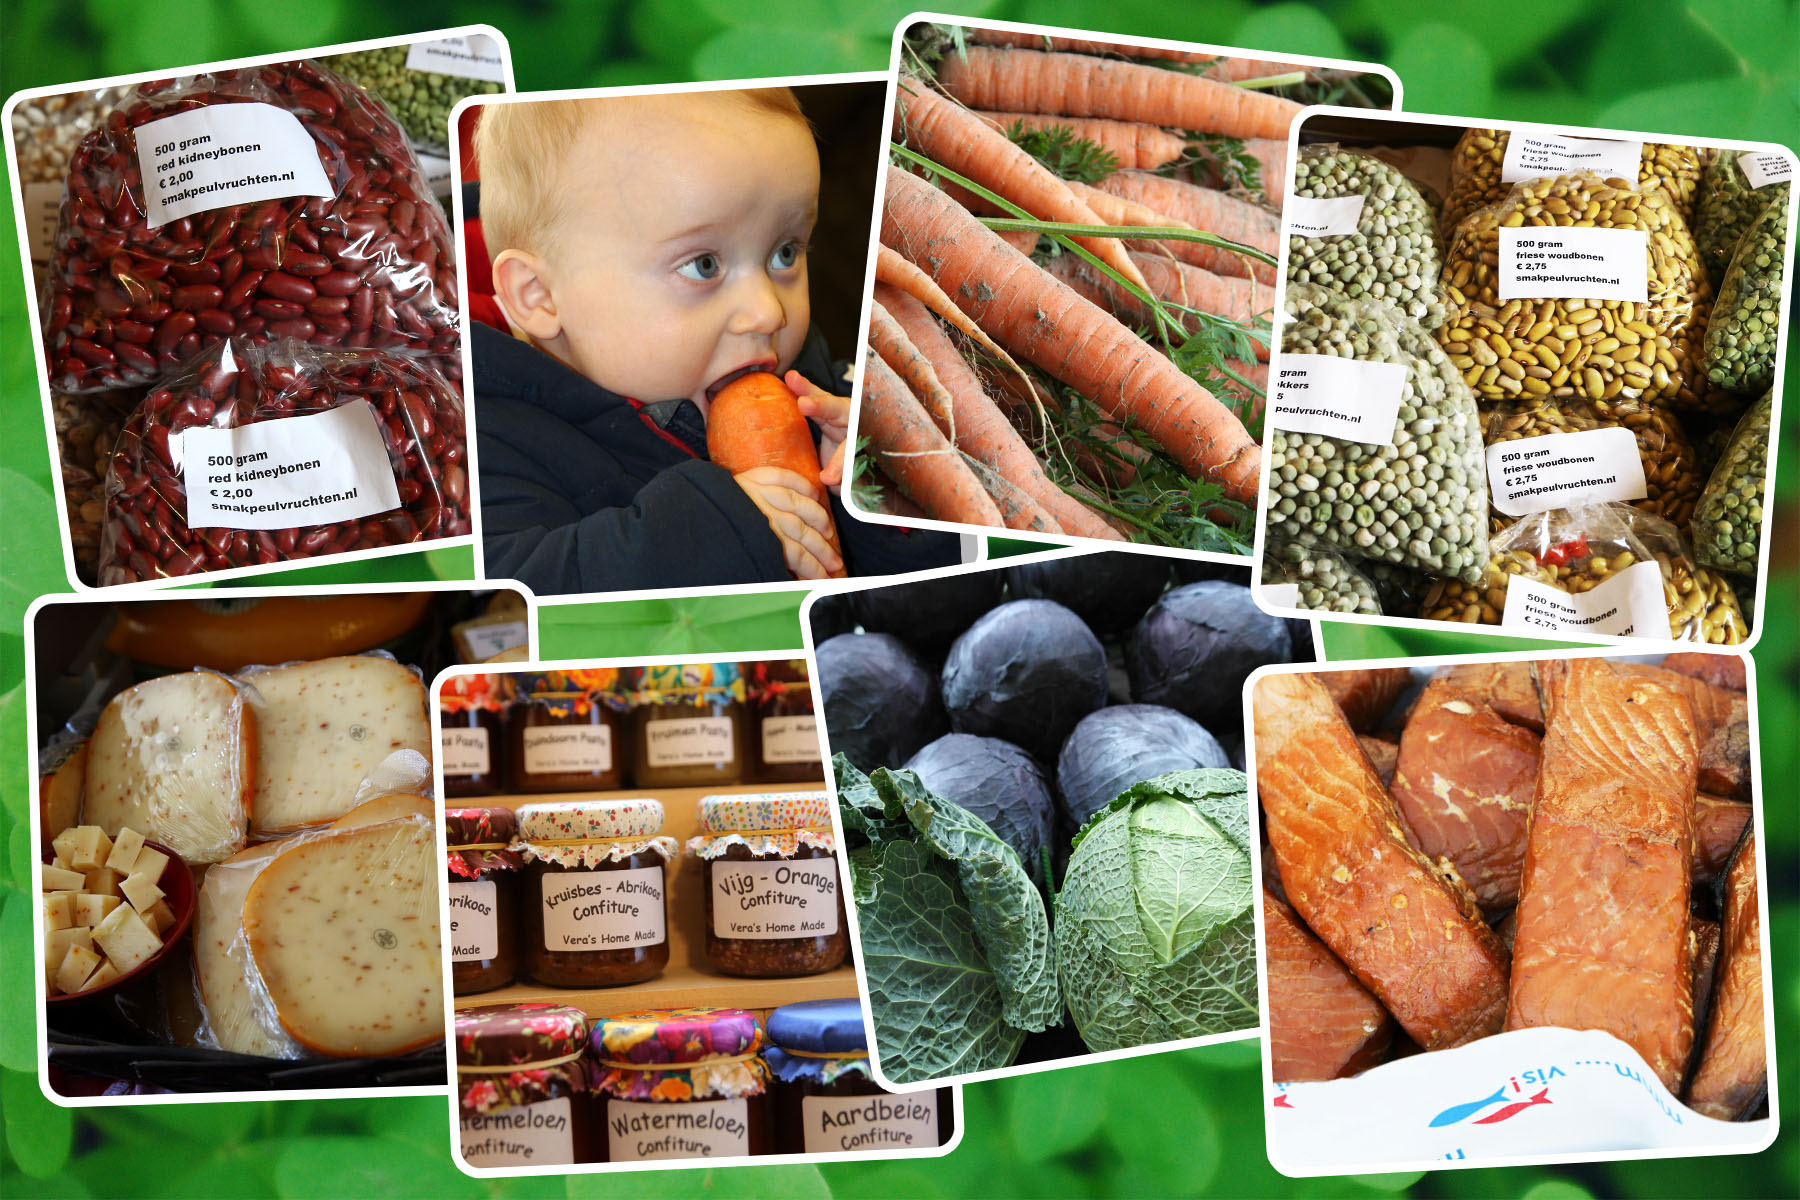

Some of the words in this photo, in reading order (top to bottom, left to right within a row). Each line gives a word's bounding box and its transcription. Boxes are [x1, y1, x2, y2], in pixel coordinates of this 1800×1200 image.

[154, 142, 176, 157] 500
[179, 135, 211, 151] gram
[1523, 146, 1549, 155] friese
[1551, 151, 1601, 159] woudbonen
[1525, 139, 1542, 147] 500
[1543, 142, 1566, 151] gram
[157, 158, 175, 173] red
[178, 142, 261, 166] kidneybonen
[159, 178, 166, 189] €
[169, 169, 194, 187] 2,00
[161, 171, 295, 206] smakpeulvruchten.nl
[1516, 240, 1535, 248] 500
[1538, 241, 1563, 249] gram
[1516, 252, 1545, 260] friese
[1548, 252, 1604, 262] woudbonen
[1525, 263, 1547, 271] 2,75
[1516, 274, 1620, 285] smakpeulvruchten.nl
[207, 455, 234, 466] 500
[236, 451, 268, 467] gram
[1501, 452, 1521, 463] 500
[1523, 449, 1550, 460] gram
[1503, 464, 1533, 475] friese
[1536, 456, 1595, 469] woudbonen
[208, 472, 231, 483] red
[236, 459, 321, 482] kidneybonen
[1506, 479, 1513, 487] €
[1515, 474, 1538, 486] 2,75
[222, 488, 253, 500] 2,00
[1508, 475, 1616, 500] smakpeulvruchten.nl
[211, 487, 358, 514] smakpeulvruchten.nl
[1527, 593, 1547, 605] 500
[1550, 601, 1577, 615] gram
[1524, 615, 1531, 623] €
[1534, 618, 1558, 631] 2,75
[1525, 605, 1556, 619] friese
[1559, 607, 1618, 625] woudbonen
[719, 873, 754, 896] Vijg
[775, 867, 834, 894] Orange
[545, 884, 602, 910] Kruisbes
[616, 881, 660, 900] Abrikoos
[740, 890, 807, 911] Confiture
[573, 900, 639, 921] Confiture
[730, 922, 761, 933] Vera's
[766, 922, 796, 932] Home
[801, 920, 825, 931] Made
[563, 934, 596, 945] Vera's
[601, 934, 630, 944] Home
[634, 930, 656, 941] Made
[452, 945, 480, 956] Made
[1510, 1065, 1567, 1093] vis!
[460, 1107, 566, 1132] termeloen
[611, 1109, 745, 1139] Watermeloen
[822, 1098, 930, 1133] Aardbeien
[637, 1135, 711, 1156] Confiture
[841, 1127, 912, 1151] Confiture
